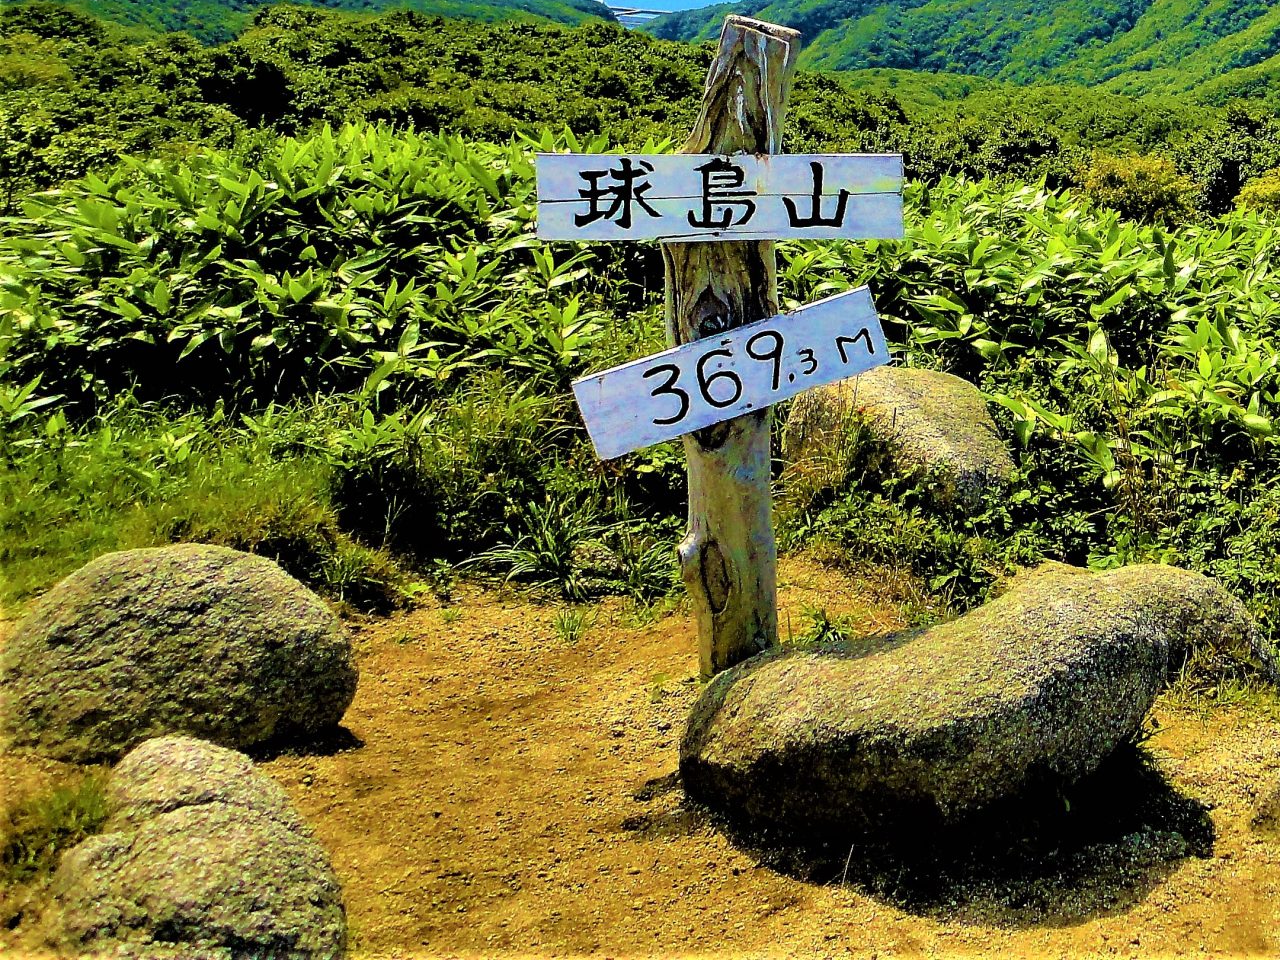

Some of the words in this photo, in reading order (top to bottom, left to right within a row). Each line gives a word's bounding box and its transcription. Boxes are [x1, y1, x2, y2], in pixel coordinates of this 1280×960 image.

[574, 157, 850, 230] 球島山
[643, 330, 818, 425] 369.3
